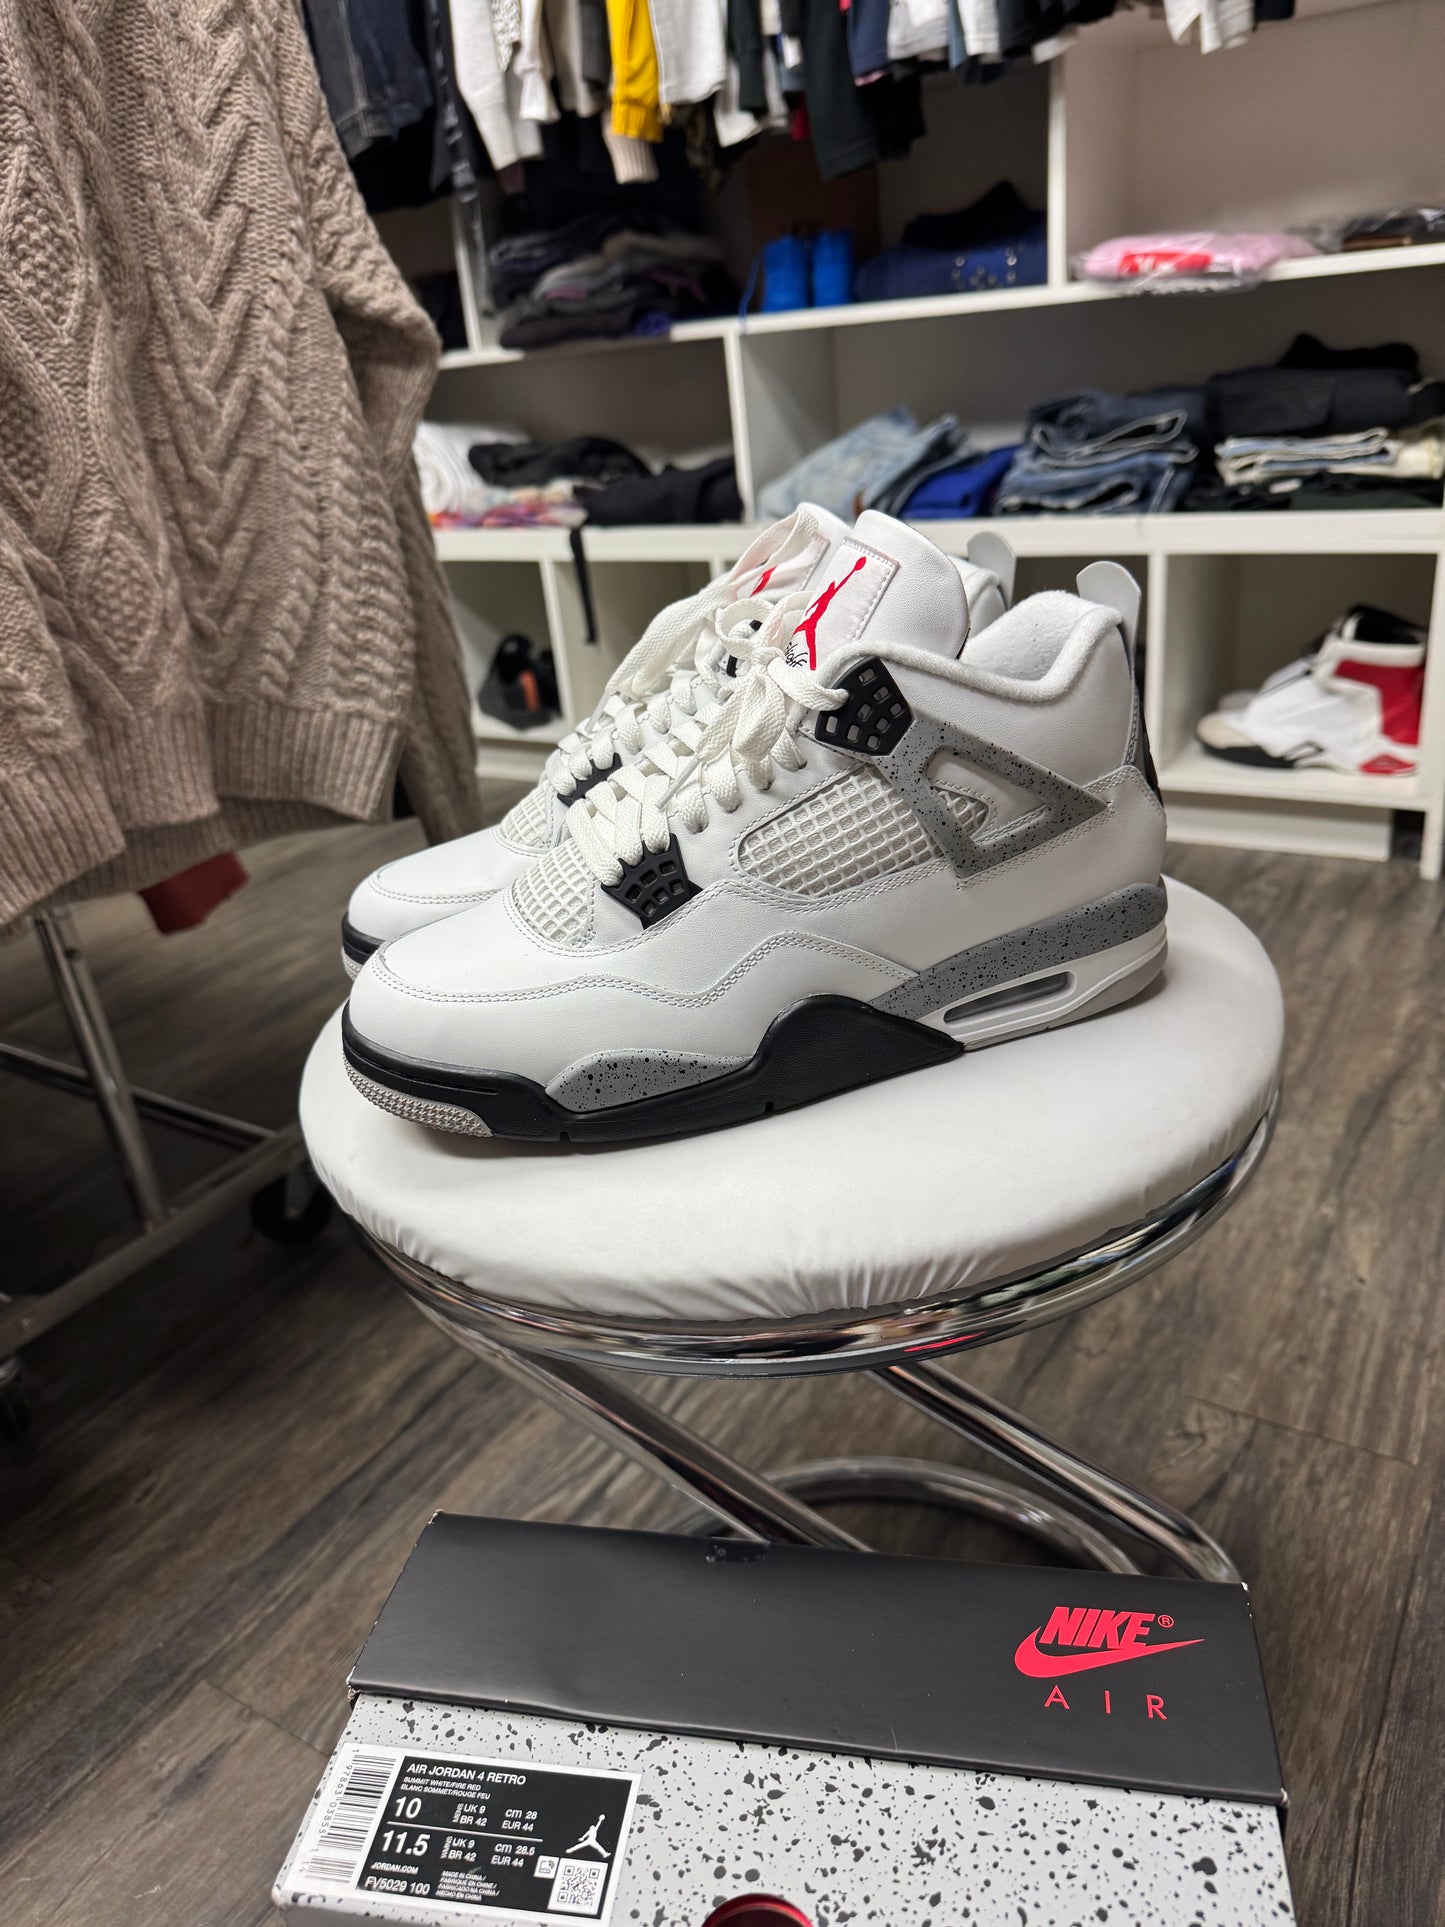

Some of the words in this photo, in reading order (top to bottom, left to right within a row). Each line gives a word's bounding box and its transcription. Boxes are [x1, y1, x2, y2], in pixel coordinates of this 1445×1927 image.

[1039, 1606, 1156, 1649] NIKE
[1044, 1685, 1167, 1720] AIR
[406, 1763, 428, 1774] AIR
[428, 1765, 476, 1780] JORDAN
[477, 1771, 485, 1781] 4
[486, 1772, 527, 1785] RETRO
[403, 1776, 430, 1785] SUMMIT
[430, 1779, 467, 1790] WHITE/FIRE
[466, 1783, 482, 1791] RED
[400, 1783, 423, 1792] BLANC
[423, 1786, 476, 1798] SOMMET/ROUGE
[476, 1792, 491, 1800] FEU
[394, 1796, 422, 1819] 10
[463, 1803, 479, 1814] UK
[479, 1805, 486, 1814] 9
[505, 1808, 522, 1819] cm
[524, 1811, 538, 1820] 28
[459, 1815, 474, 1825] BR
[474, 1817, 488, 1827] 42
[501, 1820, 521, 1831] EUR
[521, 1822, 534, 1832] 44
[382, 1830, 431, 1856] 11.5
[452, 1837, 467, 1848] UK
[468, 1839, 475, 1849] 9
[494, 1843, 512, 1853] cm
[514, 1845, 535, 1856] 28.5
[448, 1849, 463, 1860] BR
[464, 1852, 477, 1862] 42
[490, 1854, 511, 1865] EUR
[511, 1857, 524, 1867] 44
[370, 1861, 419, 1875] JORDAN.COM
[364, 1875, 408, 1893] FV5029
[409, 1881, 431, 1896] 100
